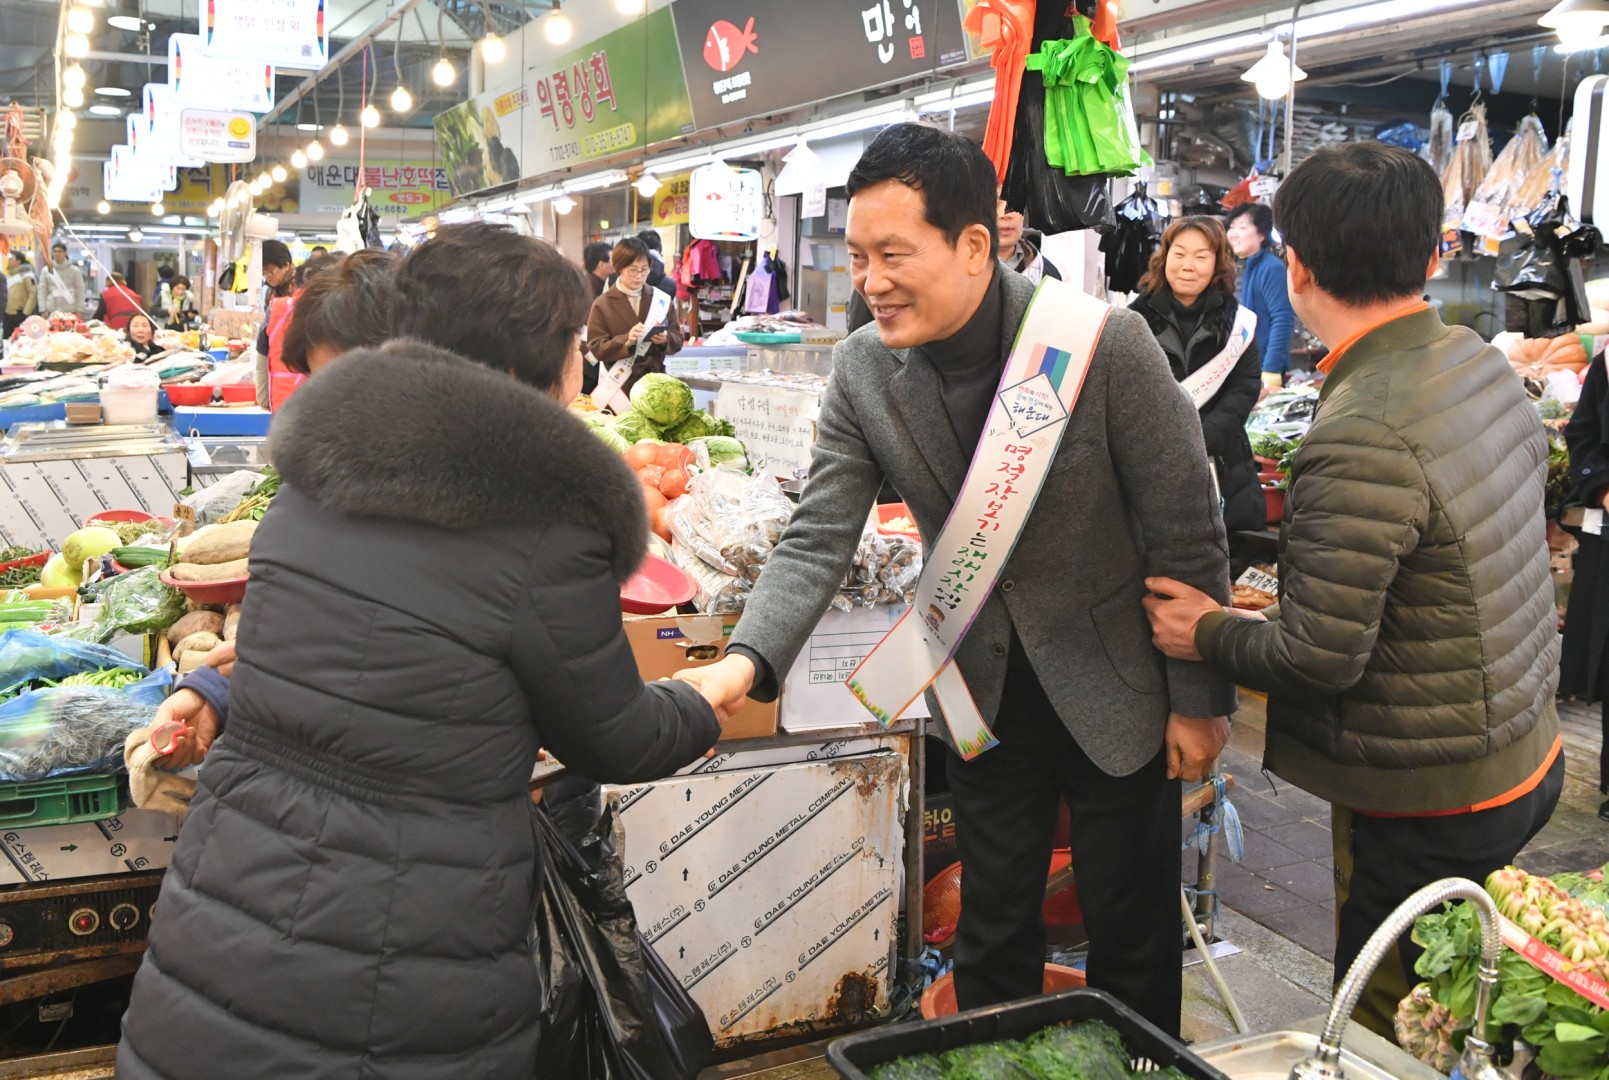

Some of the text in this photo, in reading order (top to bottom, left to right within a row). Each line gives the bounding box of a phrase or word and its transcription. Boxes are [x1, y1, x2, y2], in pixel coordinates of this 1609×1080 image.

[536, 50, 617, 130] 의령상회
[1012, 402, 1050, 421] 해운대
[661, 629, 674, 637] NH
[812, 672, 833, 682] 국내산
[670, 773, 762, 845] DAE YOUNG METAL
[718, 774, 853, 884] DAE YOUNG METAL COMPANY
[764, 900, 786, 921] DAE
[786, 873, 819, 901] YOUNG
[808, 887, 891, 955] DAE YOUNG METAL
